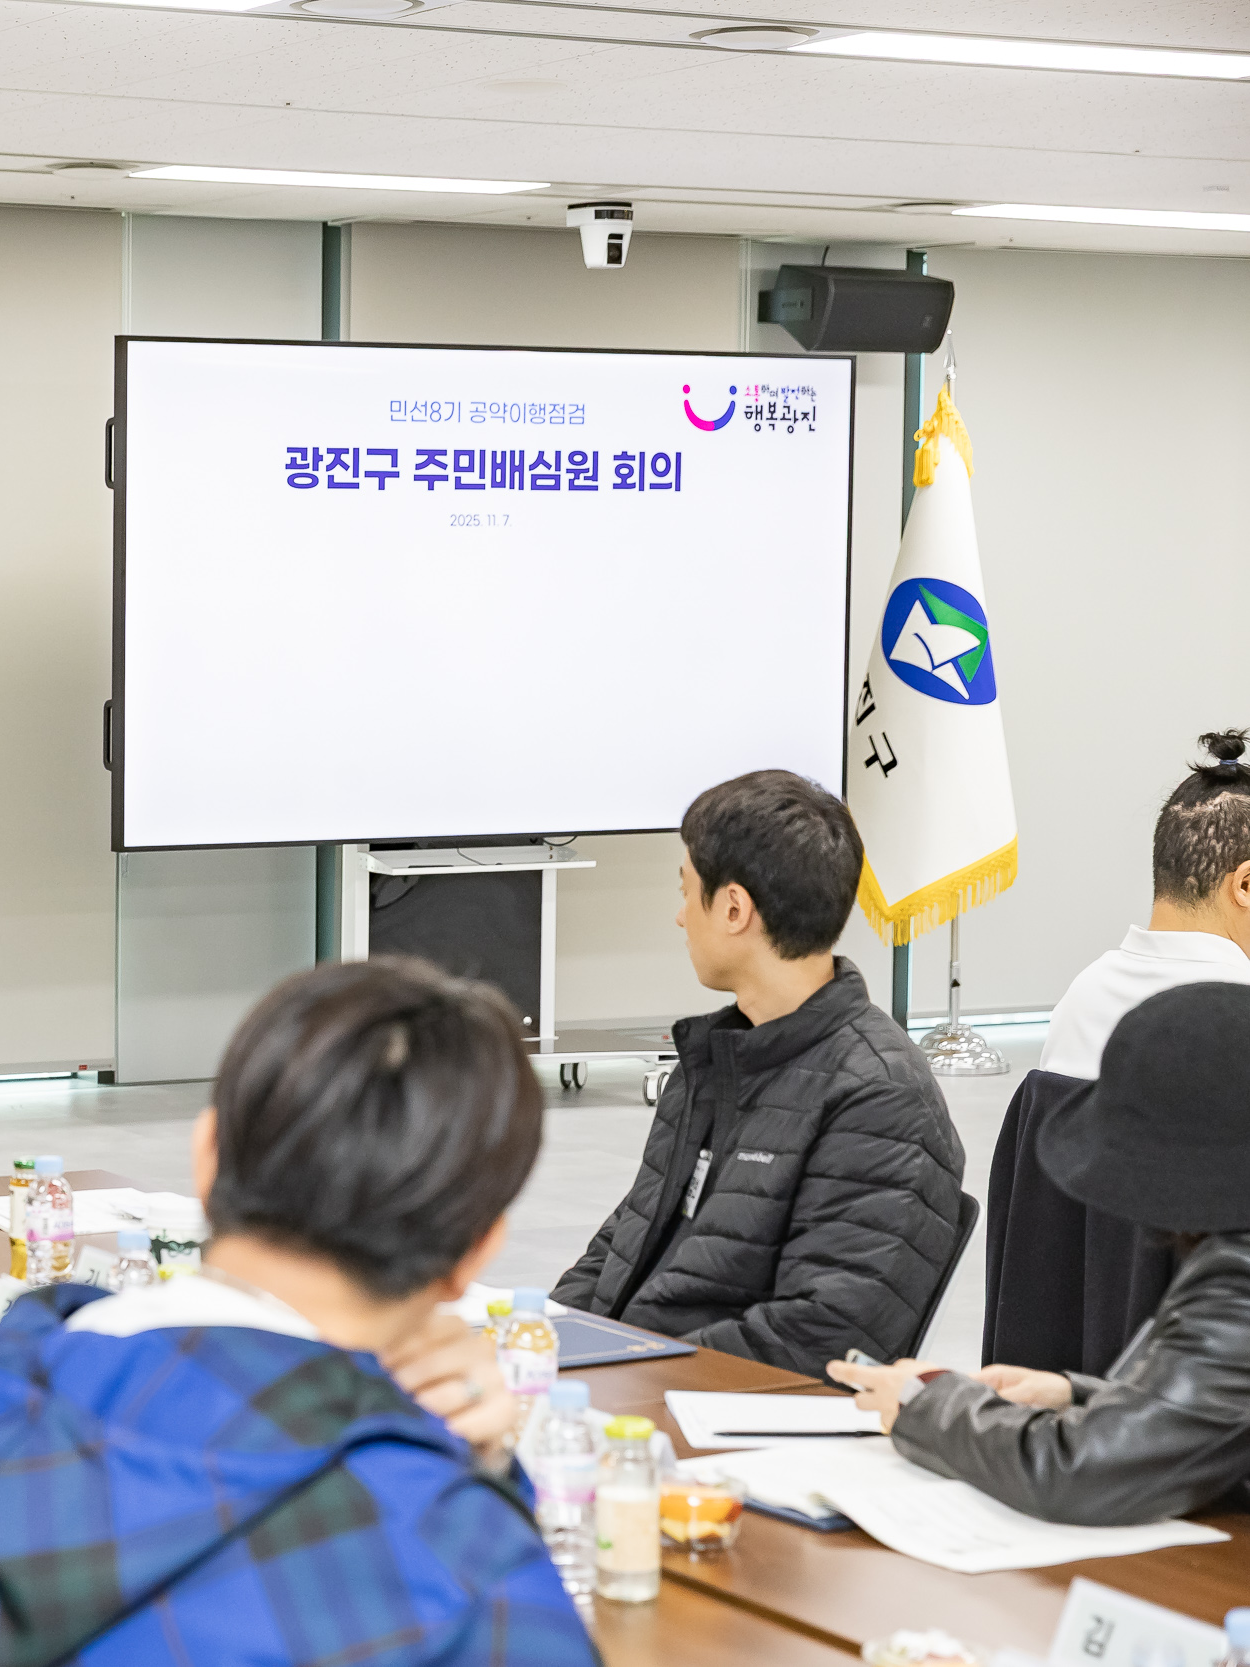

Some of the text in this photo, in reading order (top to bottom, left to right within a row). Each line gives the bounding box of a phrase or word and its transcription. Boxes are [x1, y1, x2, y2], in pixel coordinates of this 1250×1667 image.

[744, 384, 779, 403] 소통하며
[389, 400, 586, 425] 민선8기 공약이행점검
[744, 401, 817, 434] 행복광진
[285, 446, 682, 492] 광진구 주민배심원 회의
[450, 513, 483, 527] 2025.
